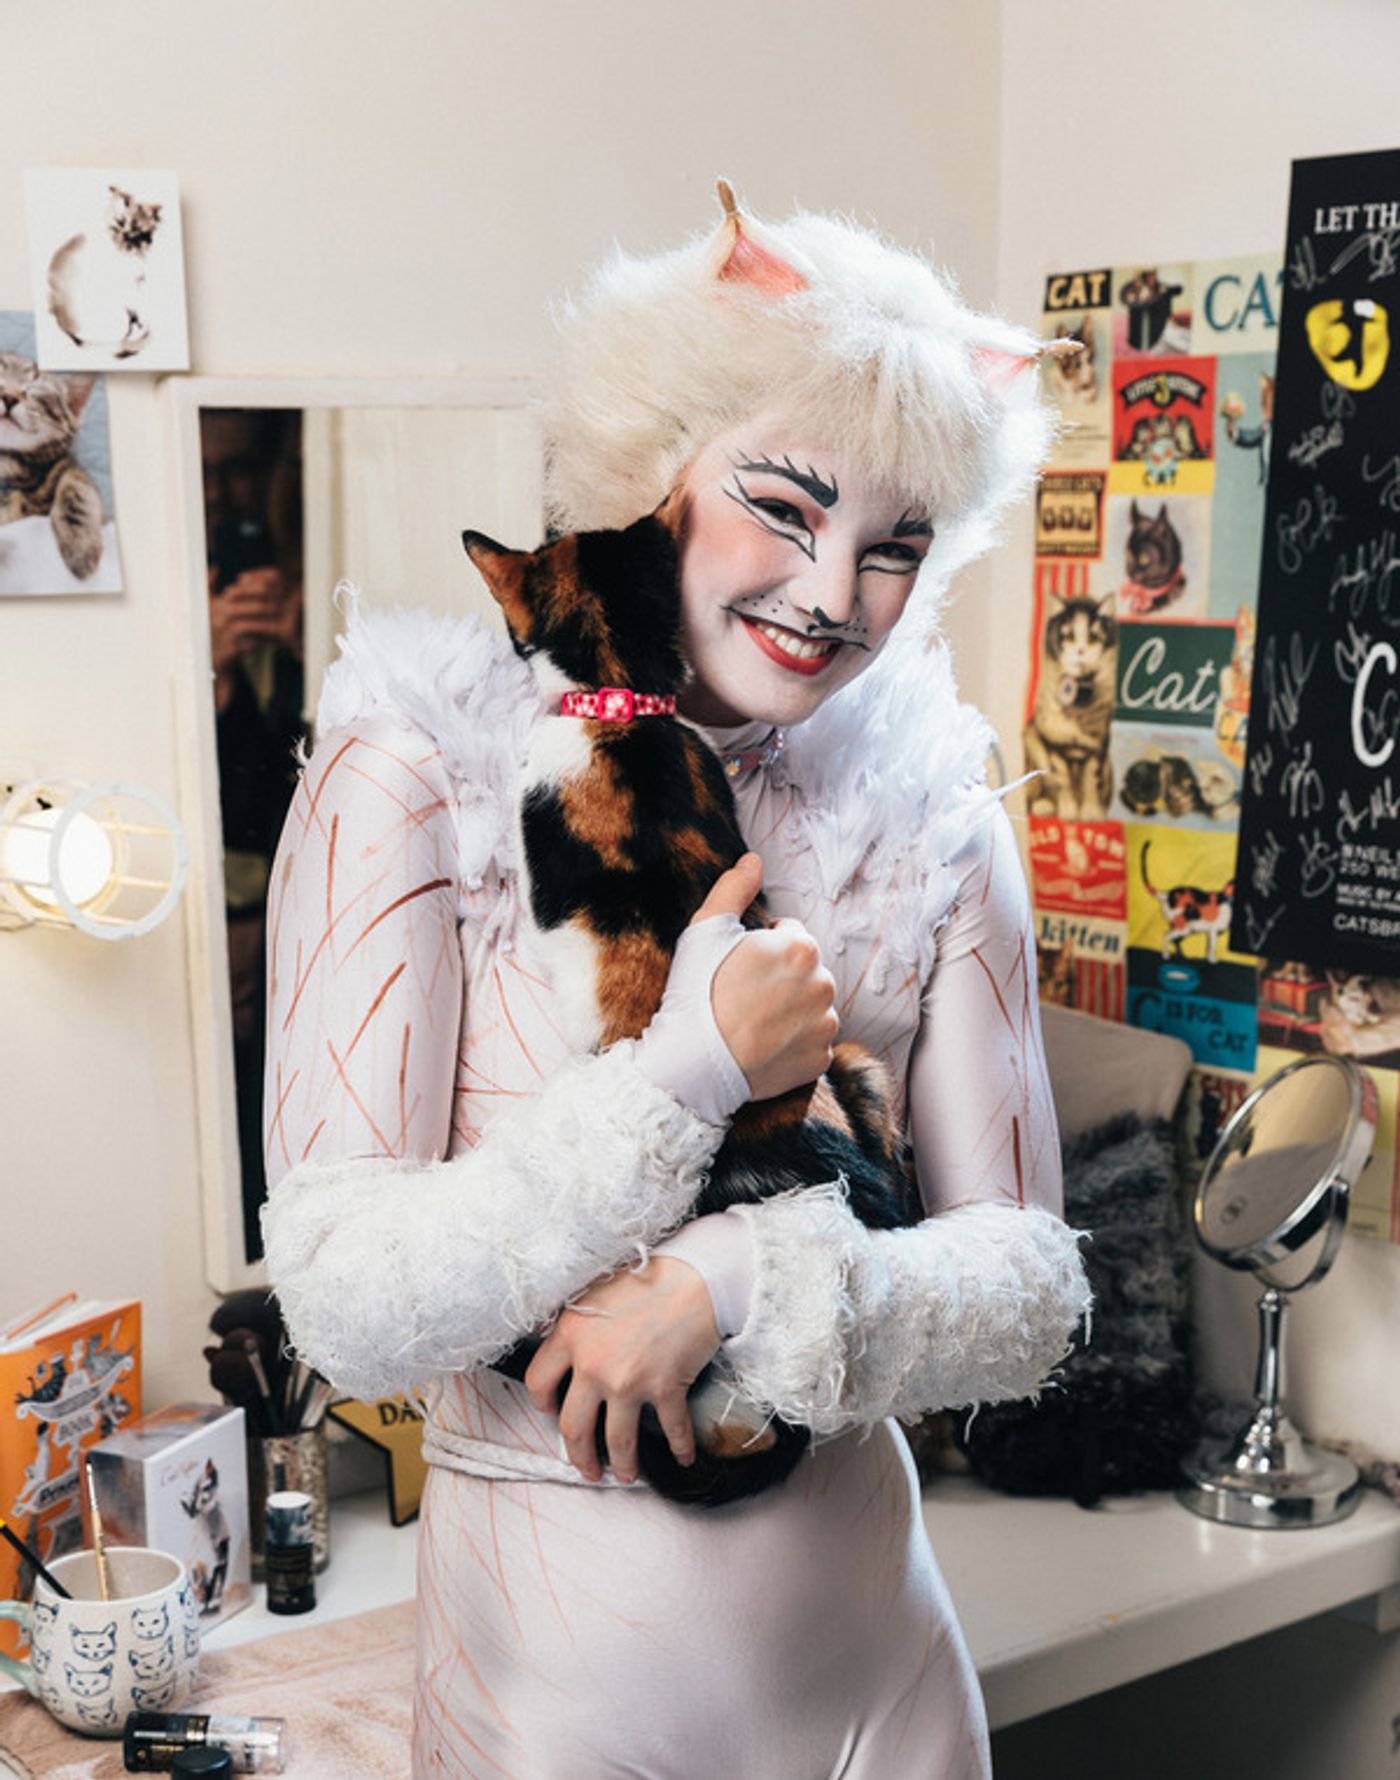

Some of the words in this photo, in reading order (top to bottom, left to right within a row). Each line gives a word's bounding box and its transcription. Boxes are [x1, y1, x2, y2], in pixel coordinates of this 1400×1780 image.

[1314, 205, 1359, 234] LET
[1048, 272, 1107, 309] CAT
[1204, 271, 1285, 333] CA
[1120, 636, 1217, 713] Cat
[1042, 916, 1119, 953] kitten
[1207, 1029, 1249, 1054] CAT
